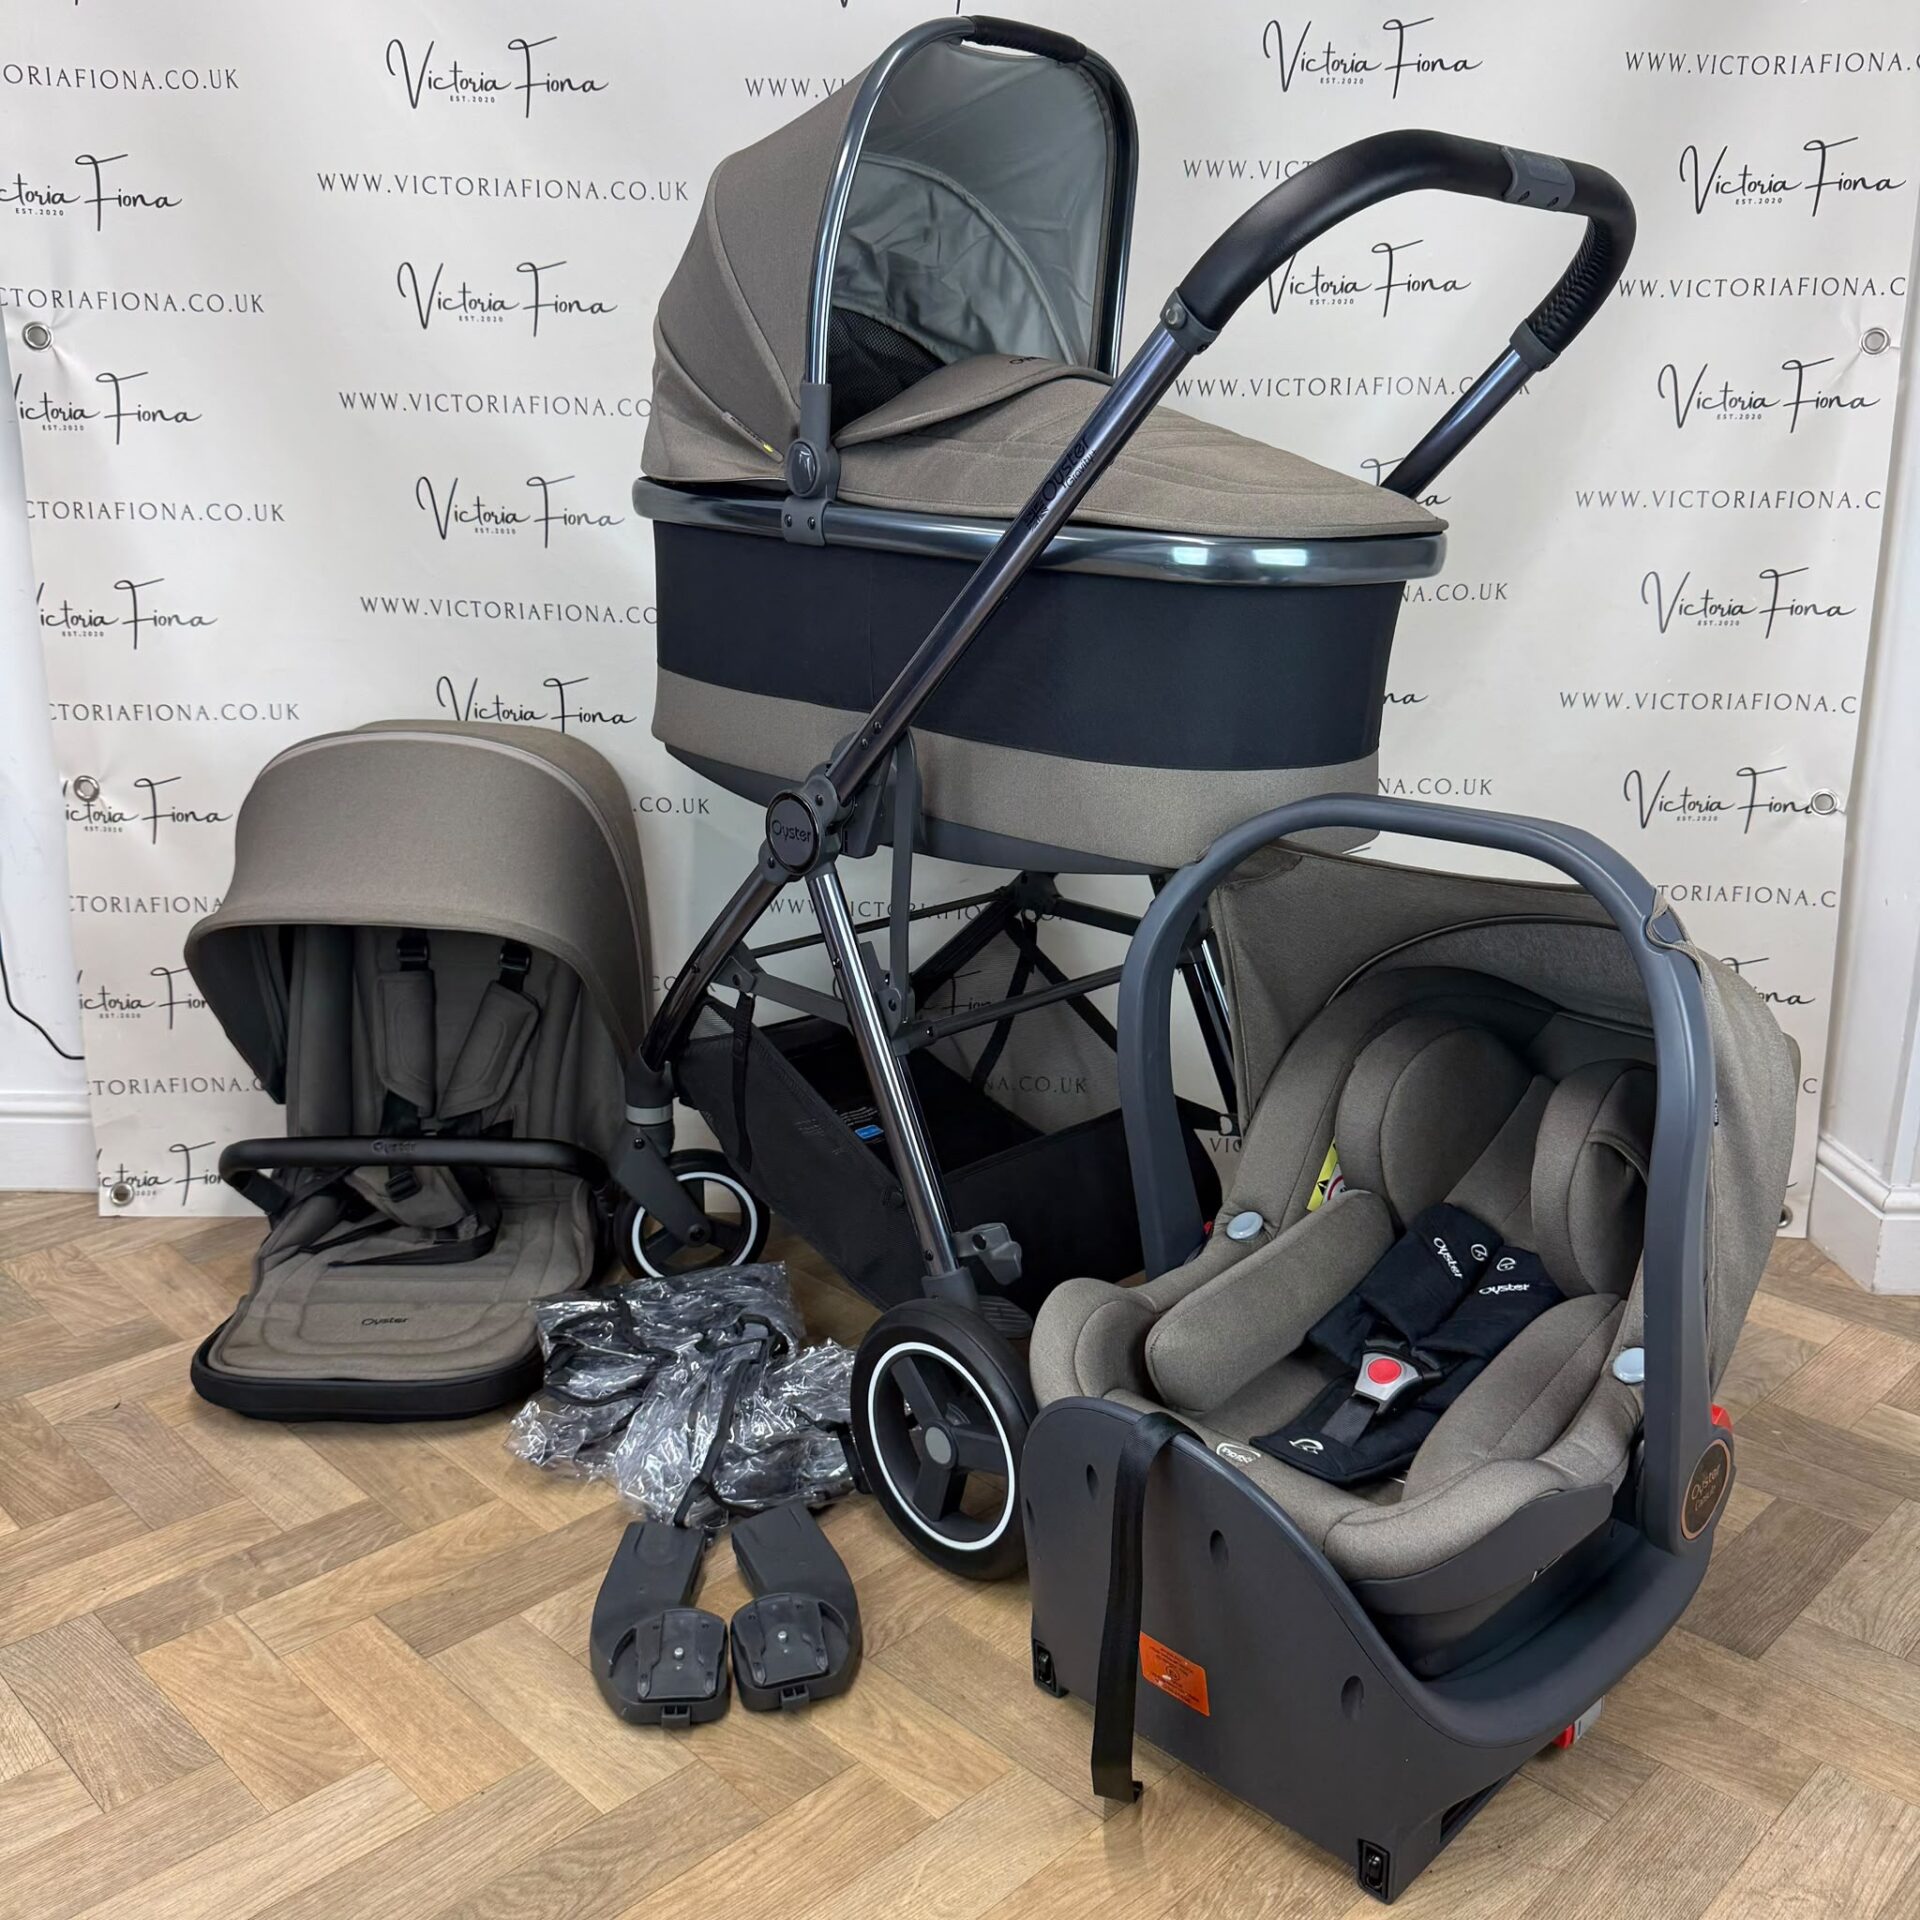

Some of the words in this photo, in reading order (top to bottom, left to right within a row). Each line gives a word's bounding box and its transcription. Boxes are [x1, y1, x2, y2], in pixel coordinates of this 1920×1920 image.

[3, 63, 239, 90] ORIAFIONA.CO.UK
[386, 39, 512, 109] Victoria
[507, 36, 609, 118] Fiona
[1263, 20, 1382, 93] Victoria
[1382, 17, 1483, 98] Fiona
[75, 154, 182, 232] Fiona
[317, 173, 689, 202] WWW.VICTORIAFIONA.CO.UK
[1680, 145, 1802, 214] Victoria
[1804, 136, 1907, 217] Fiona
[397, 262, 519, 330] Victoria
[516, 261, 617, 337] Fiona
[1371, 240, 1471, 317] Fiona
[96, 371, 203, 445] Fiona
[1658, 363, 1780, 429] Victoria
[1782, 357, 1880, 433] Fiona
[1041, 433, 1089, 501] Oyster
[1575, 489, 1881, 510] WWW.VICTORIAFIONA.C
[416, 476, 531, 540] Victoria
[526, 475, 625, 549] Fiona
[114, 577, 218, 650] Fiona
[1641, 571, 1758, 634] Victoria
[1758, 566, 1856, 639] Fiona
[436, 676, 548, 721] Victoria
[543, 677, 637, 733] Fiona
[1560, 691, 1857, 713] WWW.VICTORIAFIONA.C
[134, 776, 234, 845] Fiona
[772, 819, 811, 842] Oyster
[1623, 769, 1735, 829] Victoria
[77, 970, 154, 1012] ictoria
[1433, 1237, 1463, 1279] Oyster
[1478, 1283, 1531, 1295] Oyster
[361, 1317, 409, 1327] Oyster
